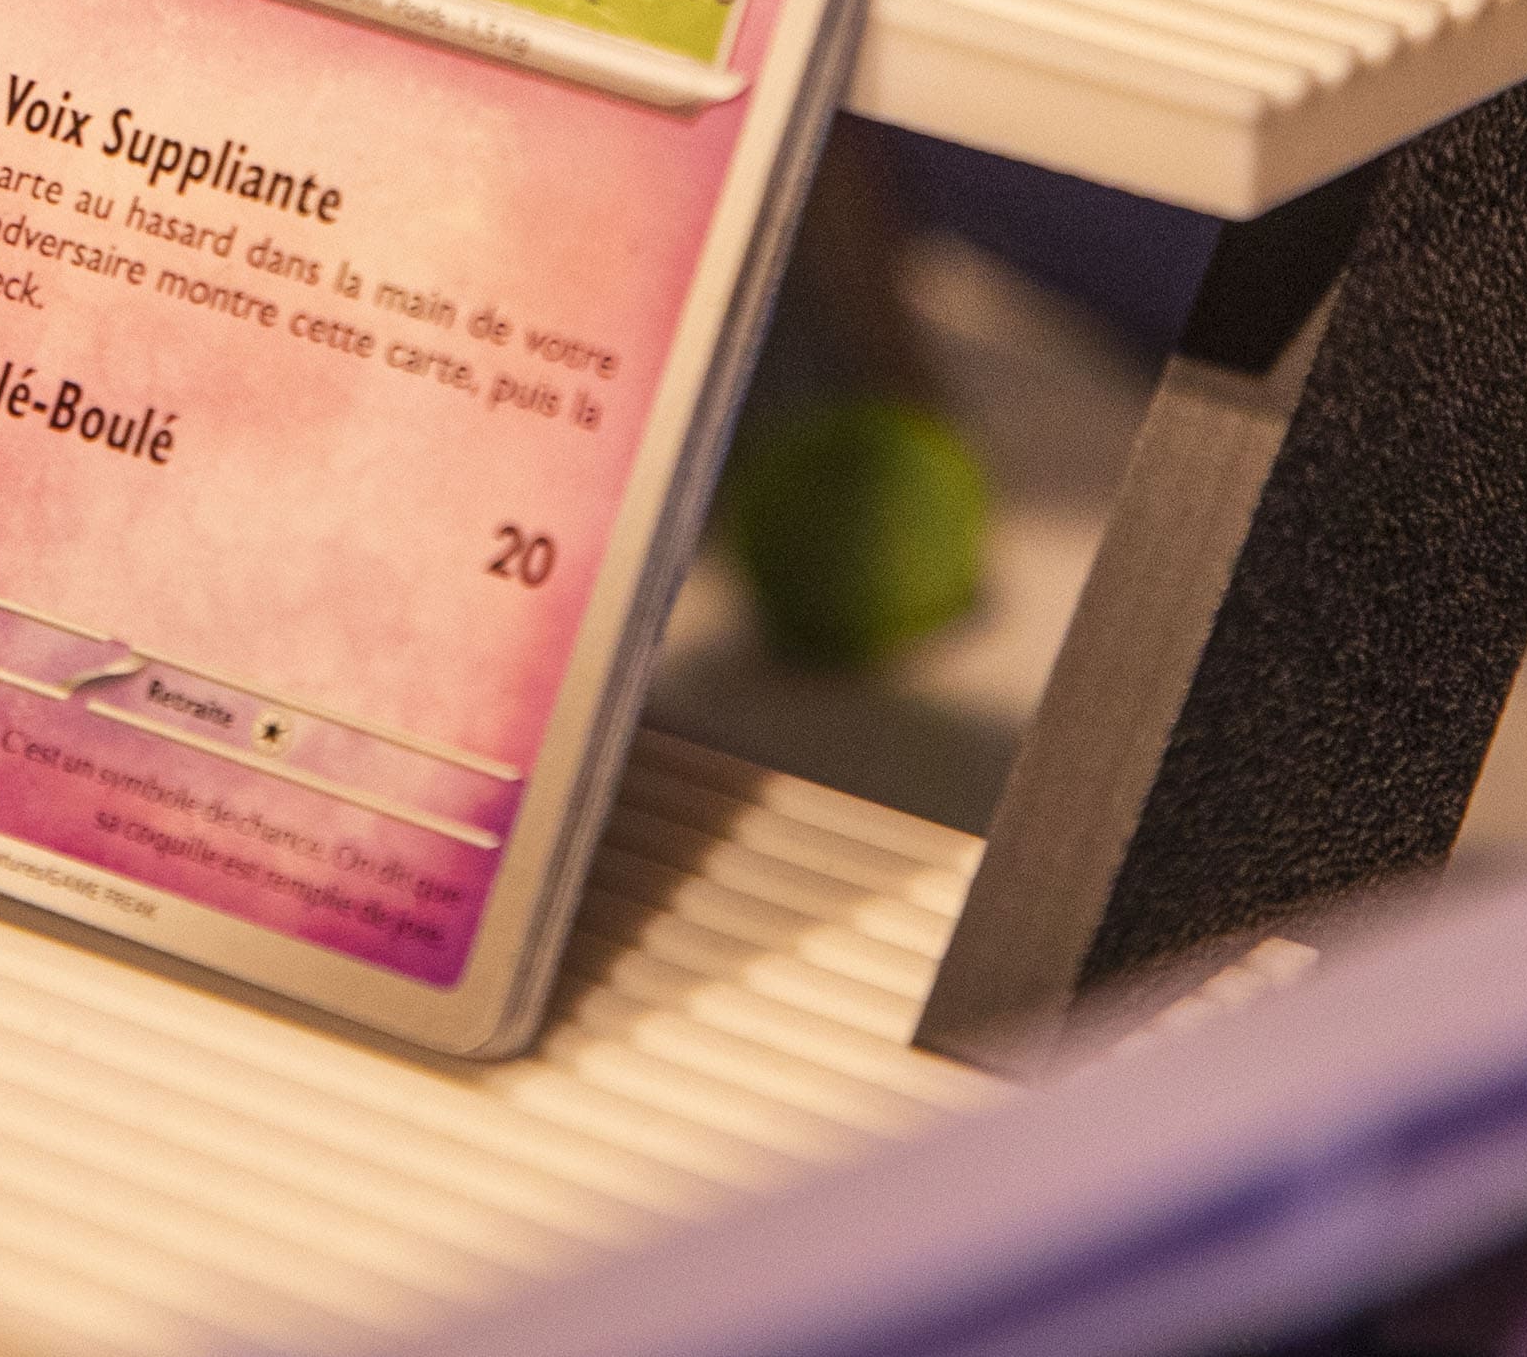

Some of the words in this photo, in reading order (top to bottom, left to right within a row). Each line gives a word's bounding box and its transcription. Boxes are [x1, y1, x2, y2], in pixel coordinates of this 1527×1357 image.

[5, 73, 95, 148] Voix
[102, 106, 343, 225] Suppliante
[74, 186, 114, 221] au
[125, 194, 237, 259] hasard
[248, 237, 322, 287] dans
[335, 260, 362, 300] la
[372, 279, 459, 330] main
[467, 303, 516, 346] de
[524, 326, 622, 380] votre
[157, 267, 281, 328] montre
[288, 308, 376, 359] cette
[384, 338, 481, 398] carte,
[487, 373, 562, 420] puis
[570, 389, 603, 432] la
[487, 524, 556, 587] 20
[147, 677, 235, 730] Retraite
